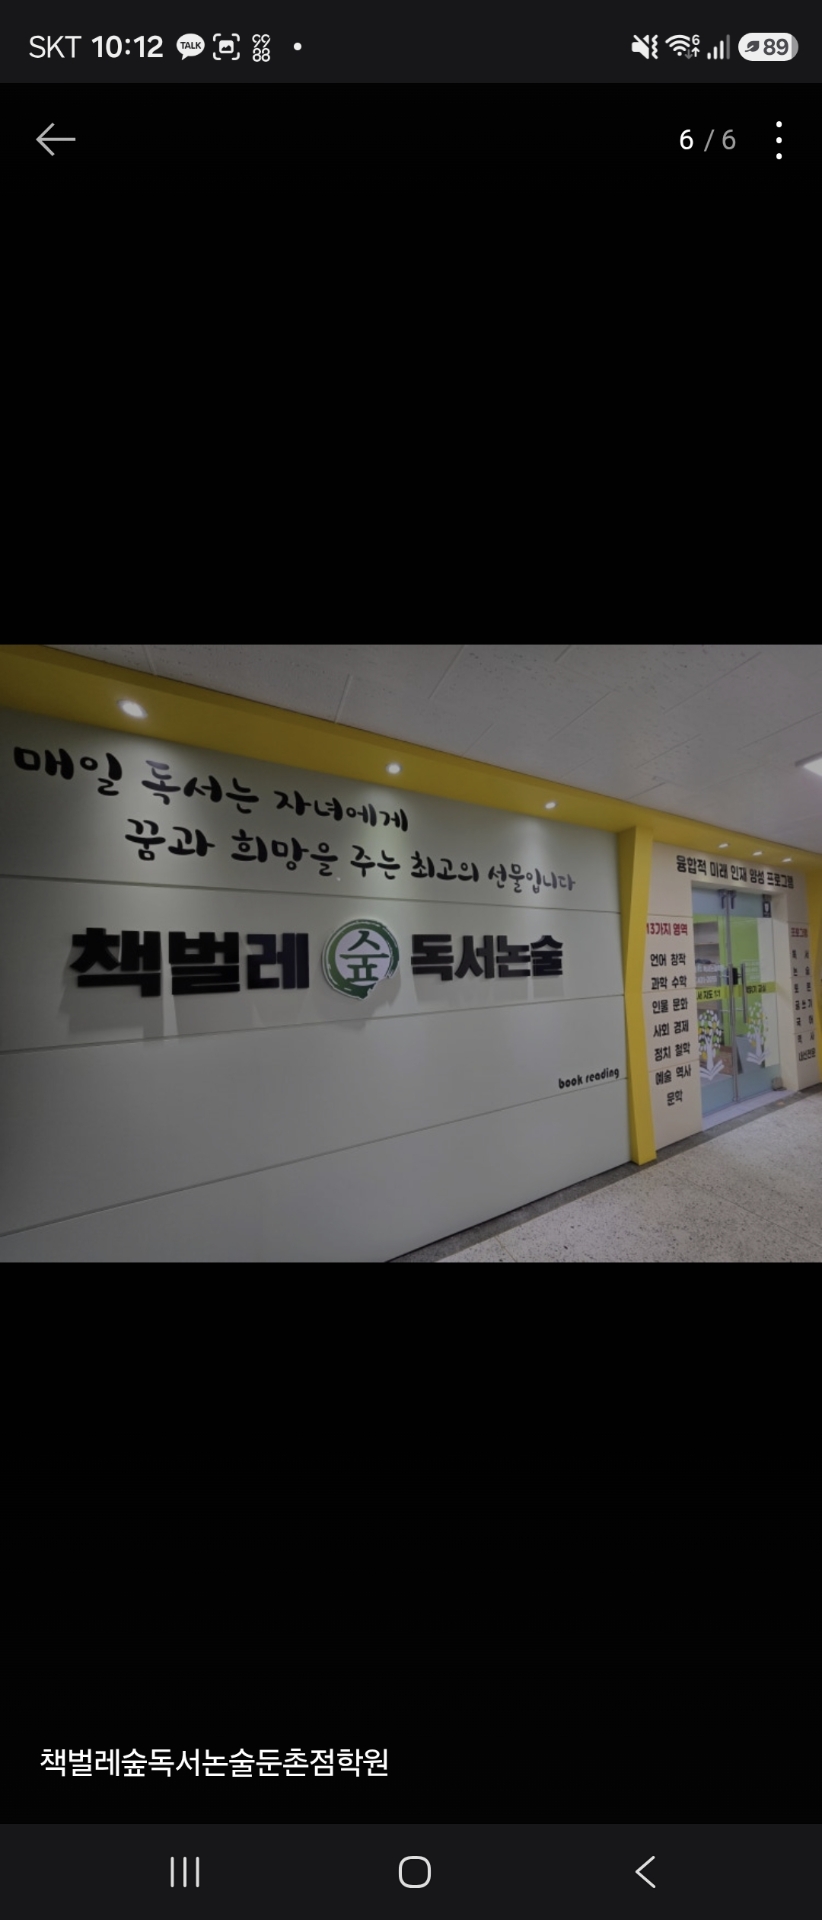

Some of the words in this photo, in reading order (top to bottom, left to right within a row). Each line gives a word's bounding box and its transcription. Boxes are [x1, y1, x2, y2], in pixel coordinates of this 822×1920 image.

[13, 745, 123, 796] 매일
[141, 760, 259, 814] 독서는
[274, 789, 410, 832] 자녀에게
[125, 818, 216, 861] 꿈과
[231, 829, 339, 877] 희망을
[350, 845, 402, 881] 주는
[410, 851, 480, 883] 최고의
[488, 863, 576, 894] 선물입니다
[676, 854, 707, 876] 융합적
[710, 861, 728, 879] 미래
[730, 865, 747, 882] 인재
[749, 868, 765, 885] 양성
[767, 871, 795, 890] 프로그램
[646, 922, 671, 936] 13가지
[673, 923, 688, 936] 영역
[70, 927, 310, 997] 책벌레
[339, 929, 390, 984] 숲
[410, 934, 564, 981] 독서논술
[650, 953, 667, 967] 언어
[670, 952, 686, 967] 창작
[651, 976, 668, 991] 과학
[671, 975, 687, 989] 수학
[652, 999, 669, 1014] 인물
[672, 997, 688, 1012] 문화
[653, 1022, 670, 1038] 사회
[673, 1019, 689, 1034] 경제
[654, 1046, 671, 1062] 정치
[675, 1042, 691, 1057] 철학
[558, 1074, 583, 1089] book
[585, 1067, 620, 1084] reading
[655, 1069, 672, 1086] 예술
[676, 1064, 692, 1079] 역사
[666, 1089, 683, 1107] 문학
